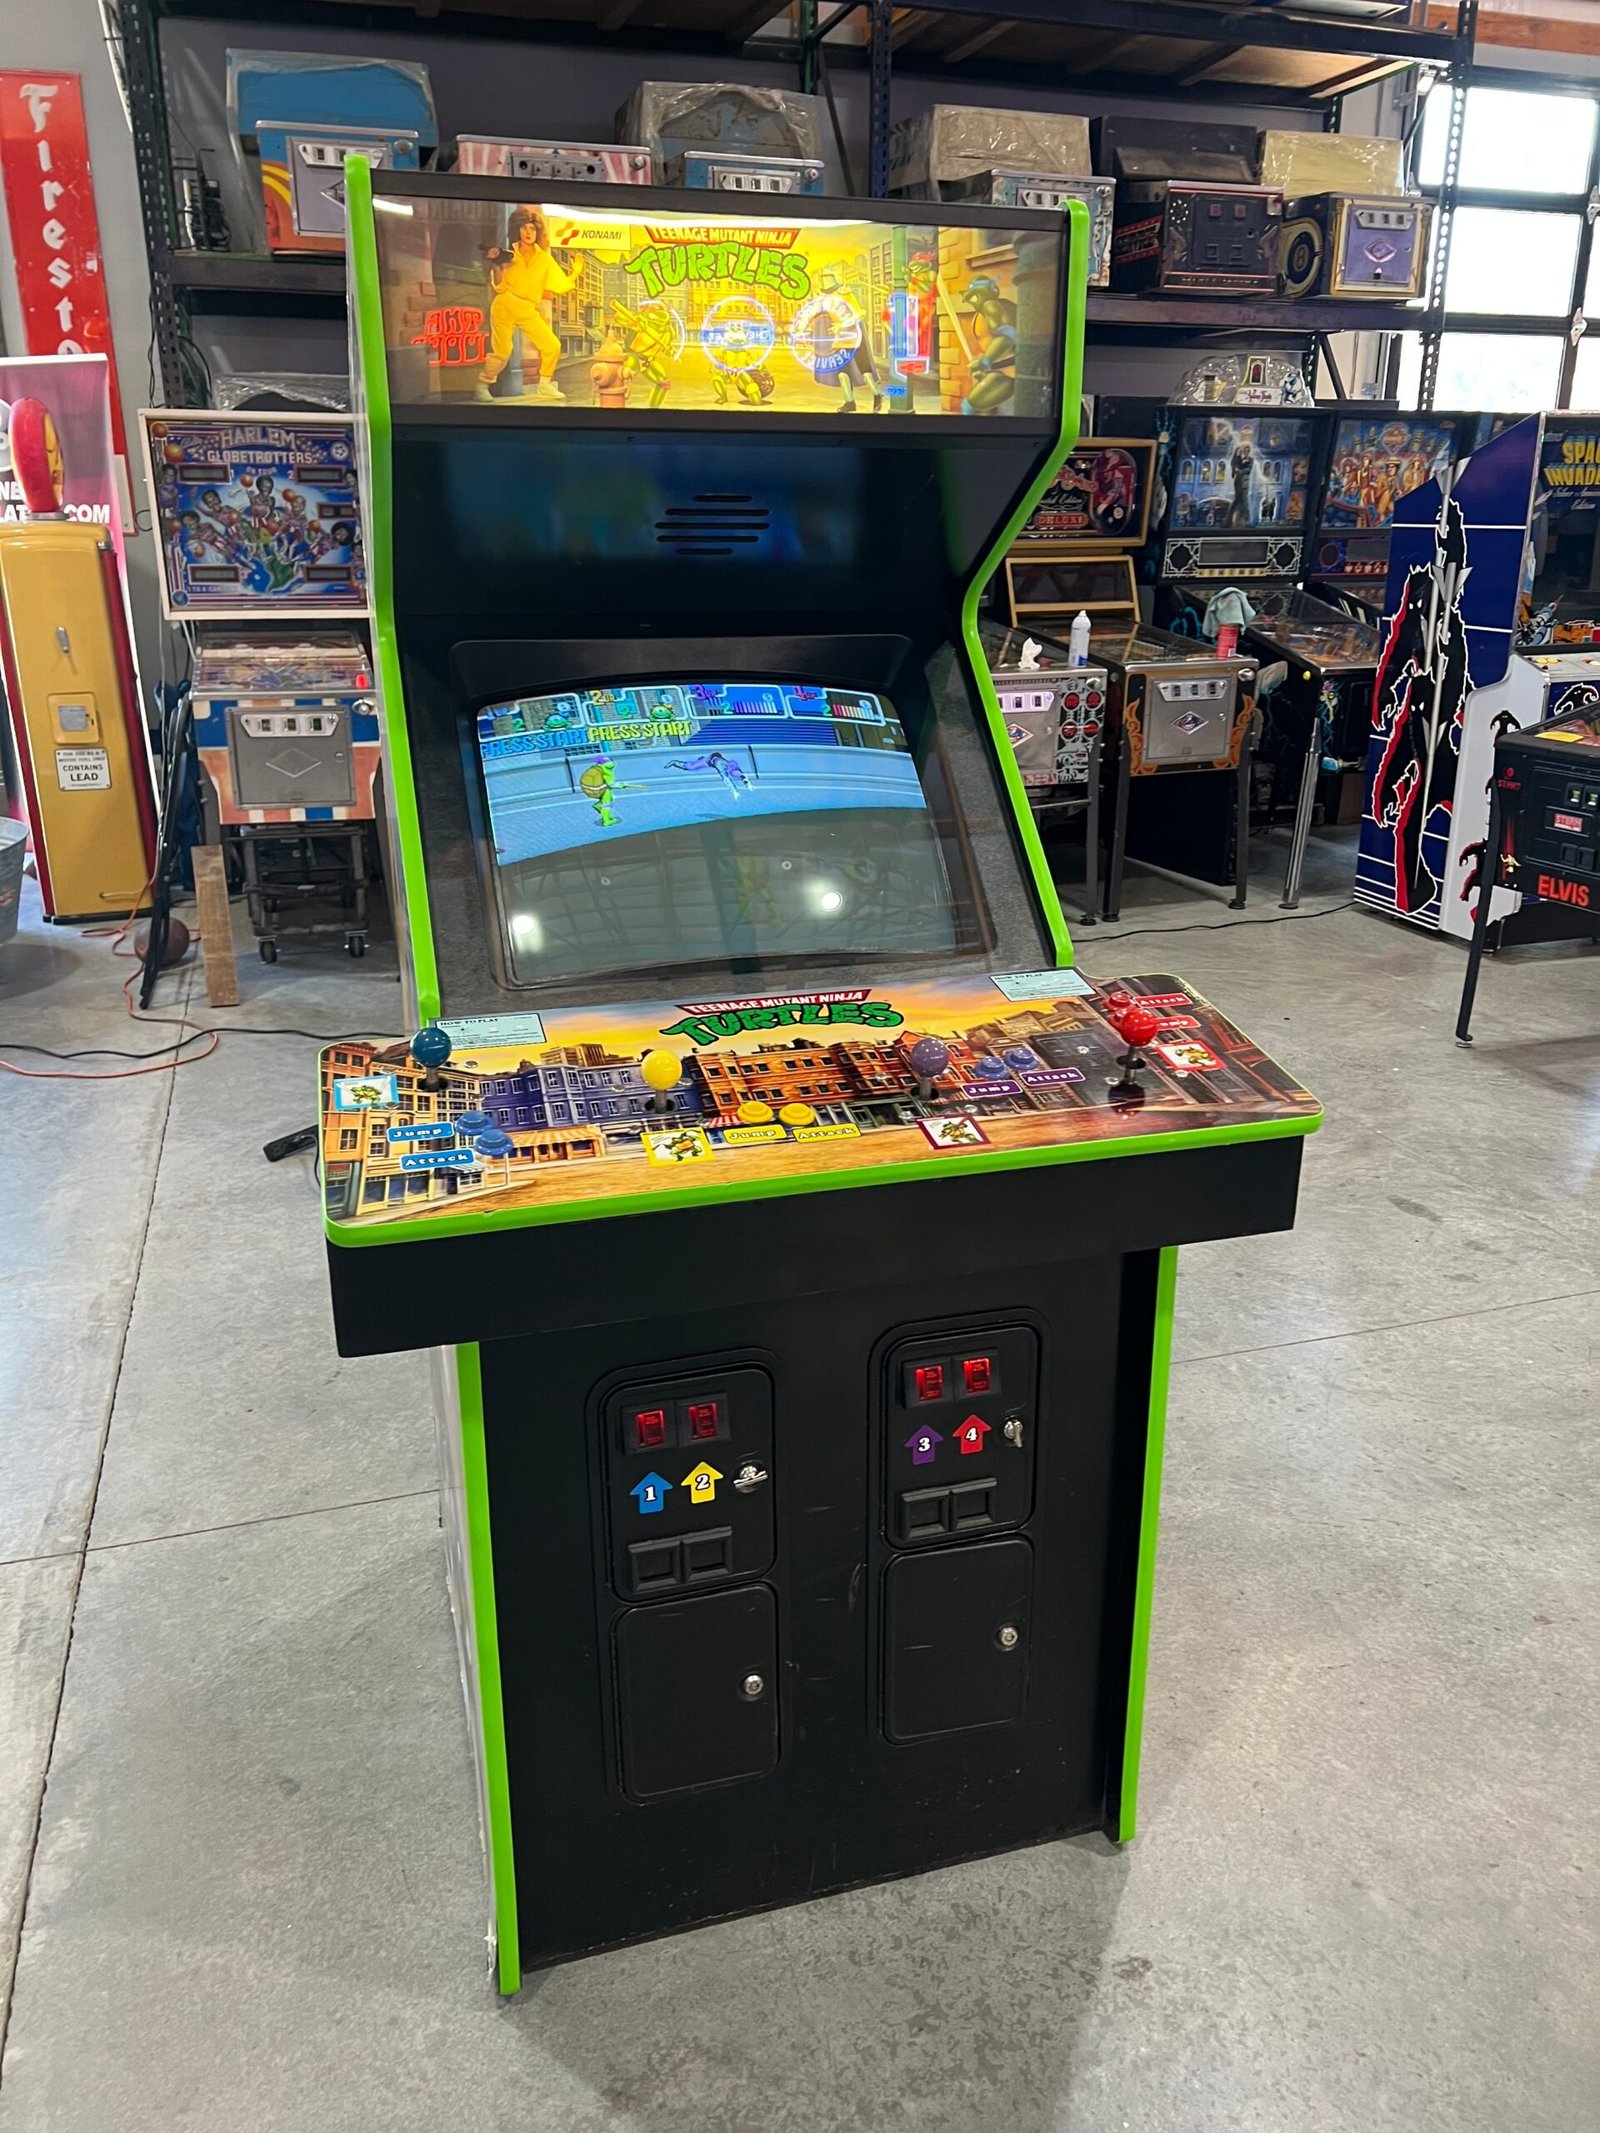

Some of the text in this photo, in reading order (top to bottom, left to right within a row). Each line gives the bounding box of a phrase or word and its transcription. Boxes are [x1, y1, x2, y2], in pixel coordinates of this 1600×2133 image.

[581, 229, 623, 240] KONAMI
[651, 227, 792, 246] TEENAGE MUTANT NINJA
[624, 241, 811, 300] TURTLES
[218, 426, 297, 449] HARLEM
[207, 449, 315, 464] GLOBETROTTERS
[588, 720, 692, 743] PRESS START
[480, 729, 588, 759] PRESS START
[62, 764, 104, 772] CONTAINS
[70, 772, 99, 782] LEAD
[1538, 875, 1591, 908] ELVIS
[689, 991, 864, 1013] TEENAGE MUTANT NINJA
[1140, 996, 1186, 1006] Attack
[660, 1002, 905, 1046] TURTLES
[1158, 1019, 1189, 1027] ump
[1027, 1071, 1078, 1083] Attack
[968, 1084, 1011, 1094] Jump
[393, 1127, 443, 1138] Jump
[729, 1129, 776, 1140] Jump
[798, 1127, 855, 1140] Attack
[403, 1153, 469, 1167] Attack
[966, 1427, 978, 1441] 4
[918, 1437, 931, 1452] 3
[695, 1473, 710, 1490] 2
[645, 1486, 656, 1502] 1
